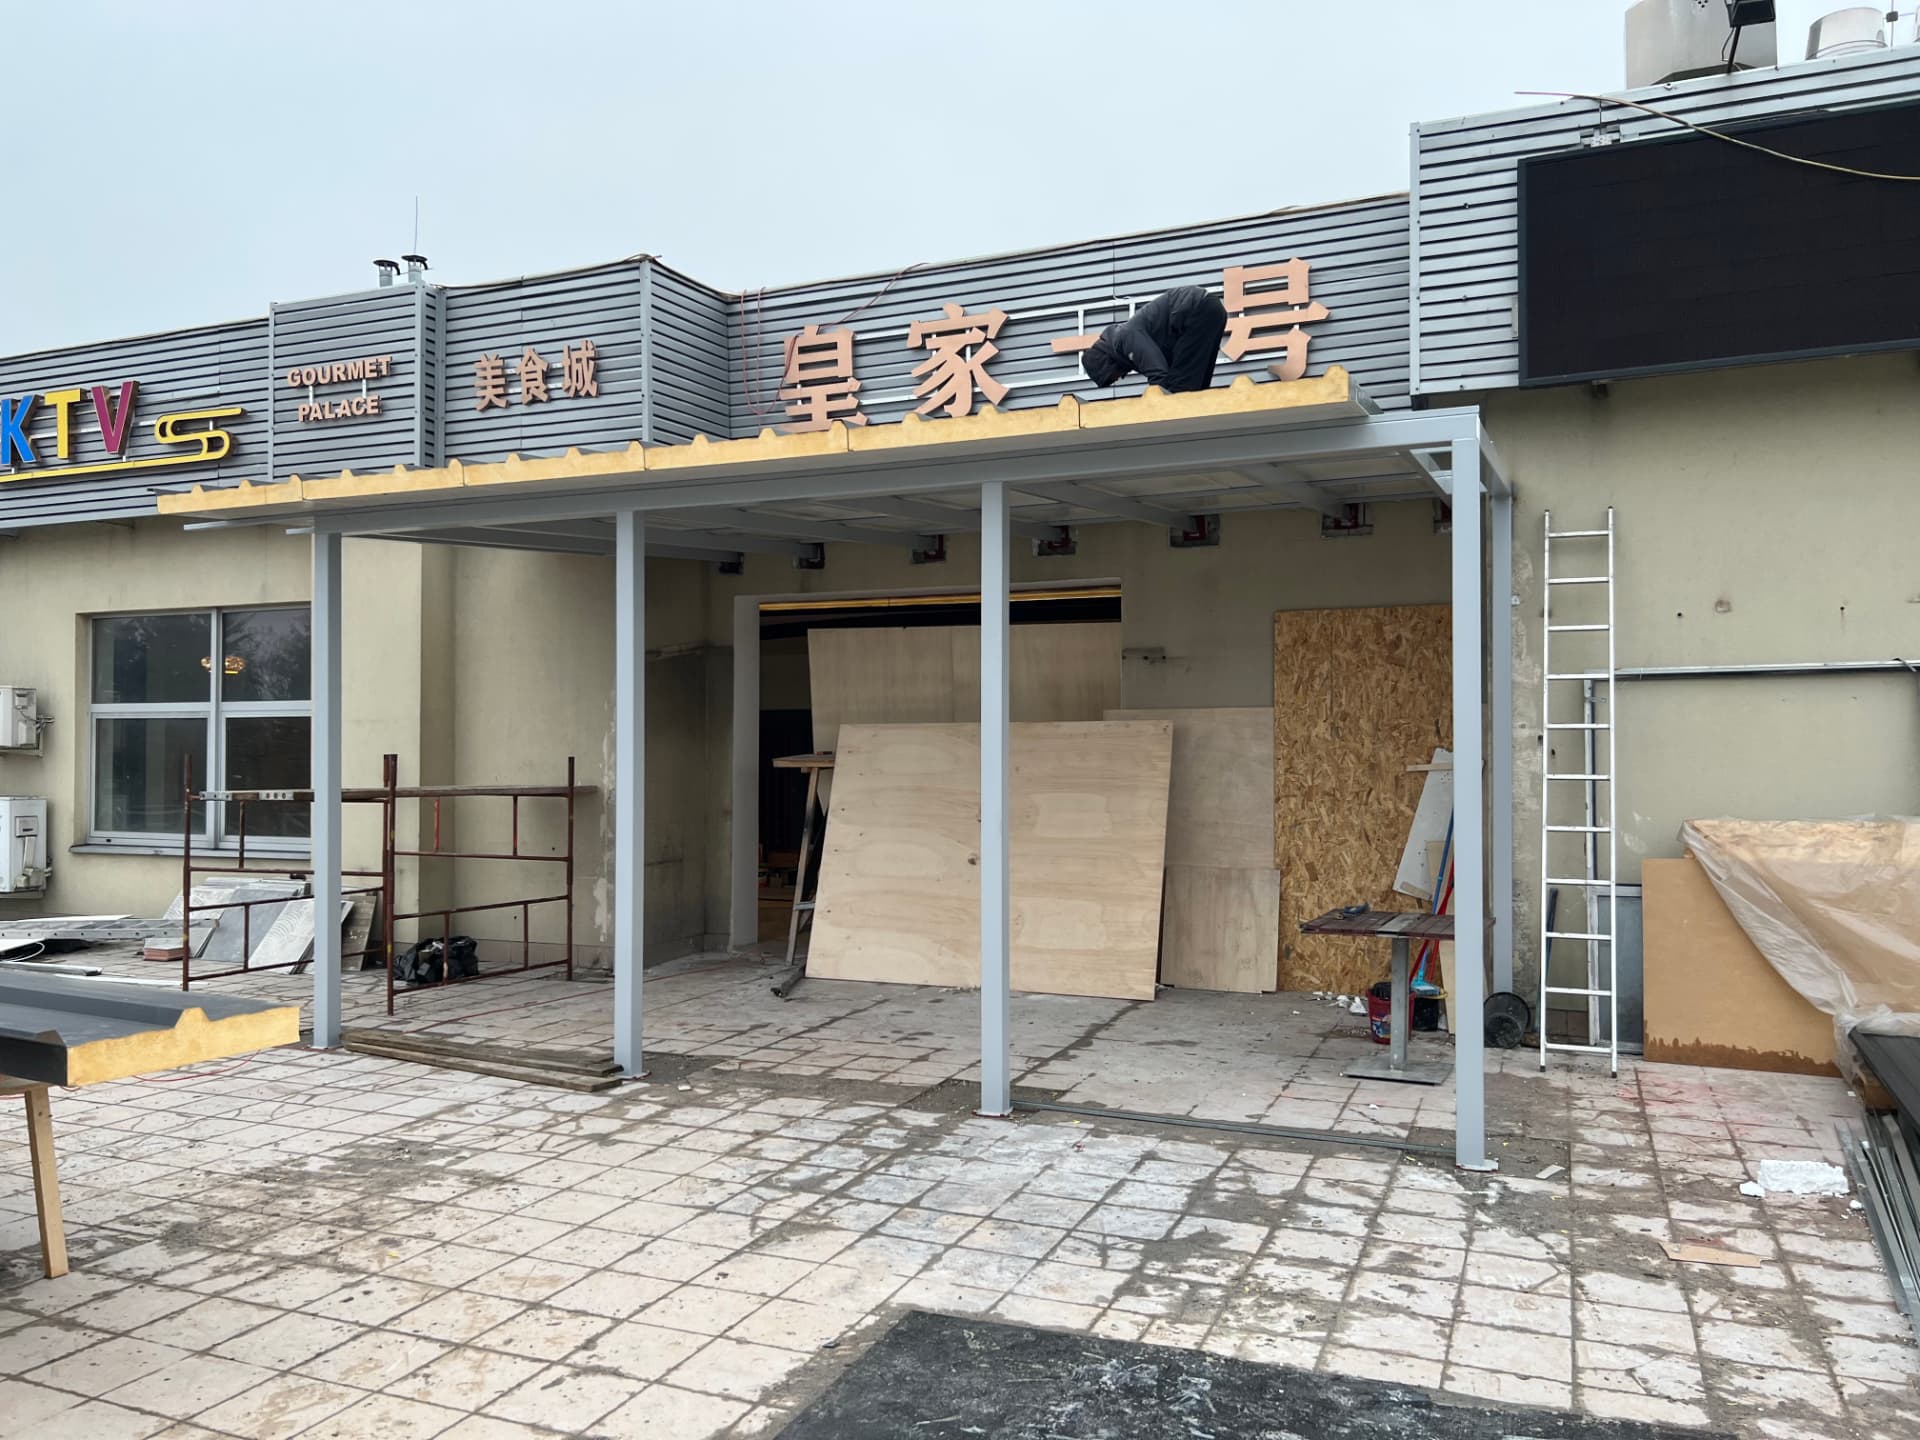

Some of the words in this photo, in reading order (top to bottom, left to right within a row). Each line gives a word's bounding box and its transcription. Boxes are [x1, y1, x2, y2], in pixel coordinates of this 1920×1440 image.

[287, 355, 392, 388] GOURMET
[474, 340, 600, 412] 美食城
[0, 380, 138, 465] KTV
[298, 395, 383, 422] PALACE
